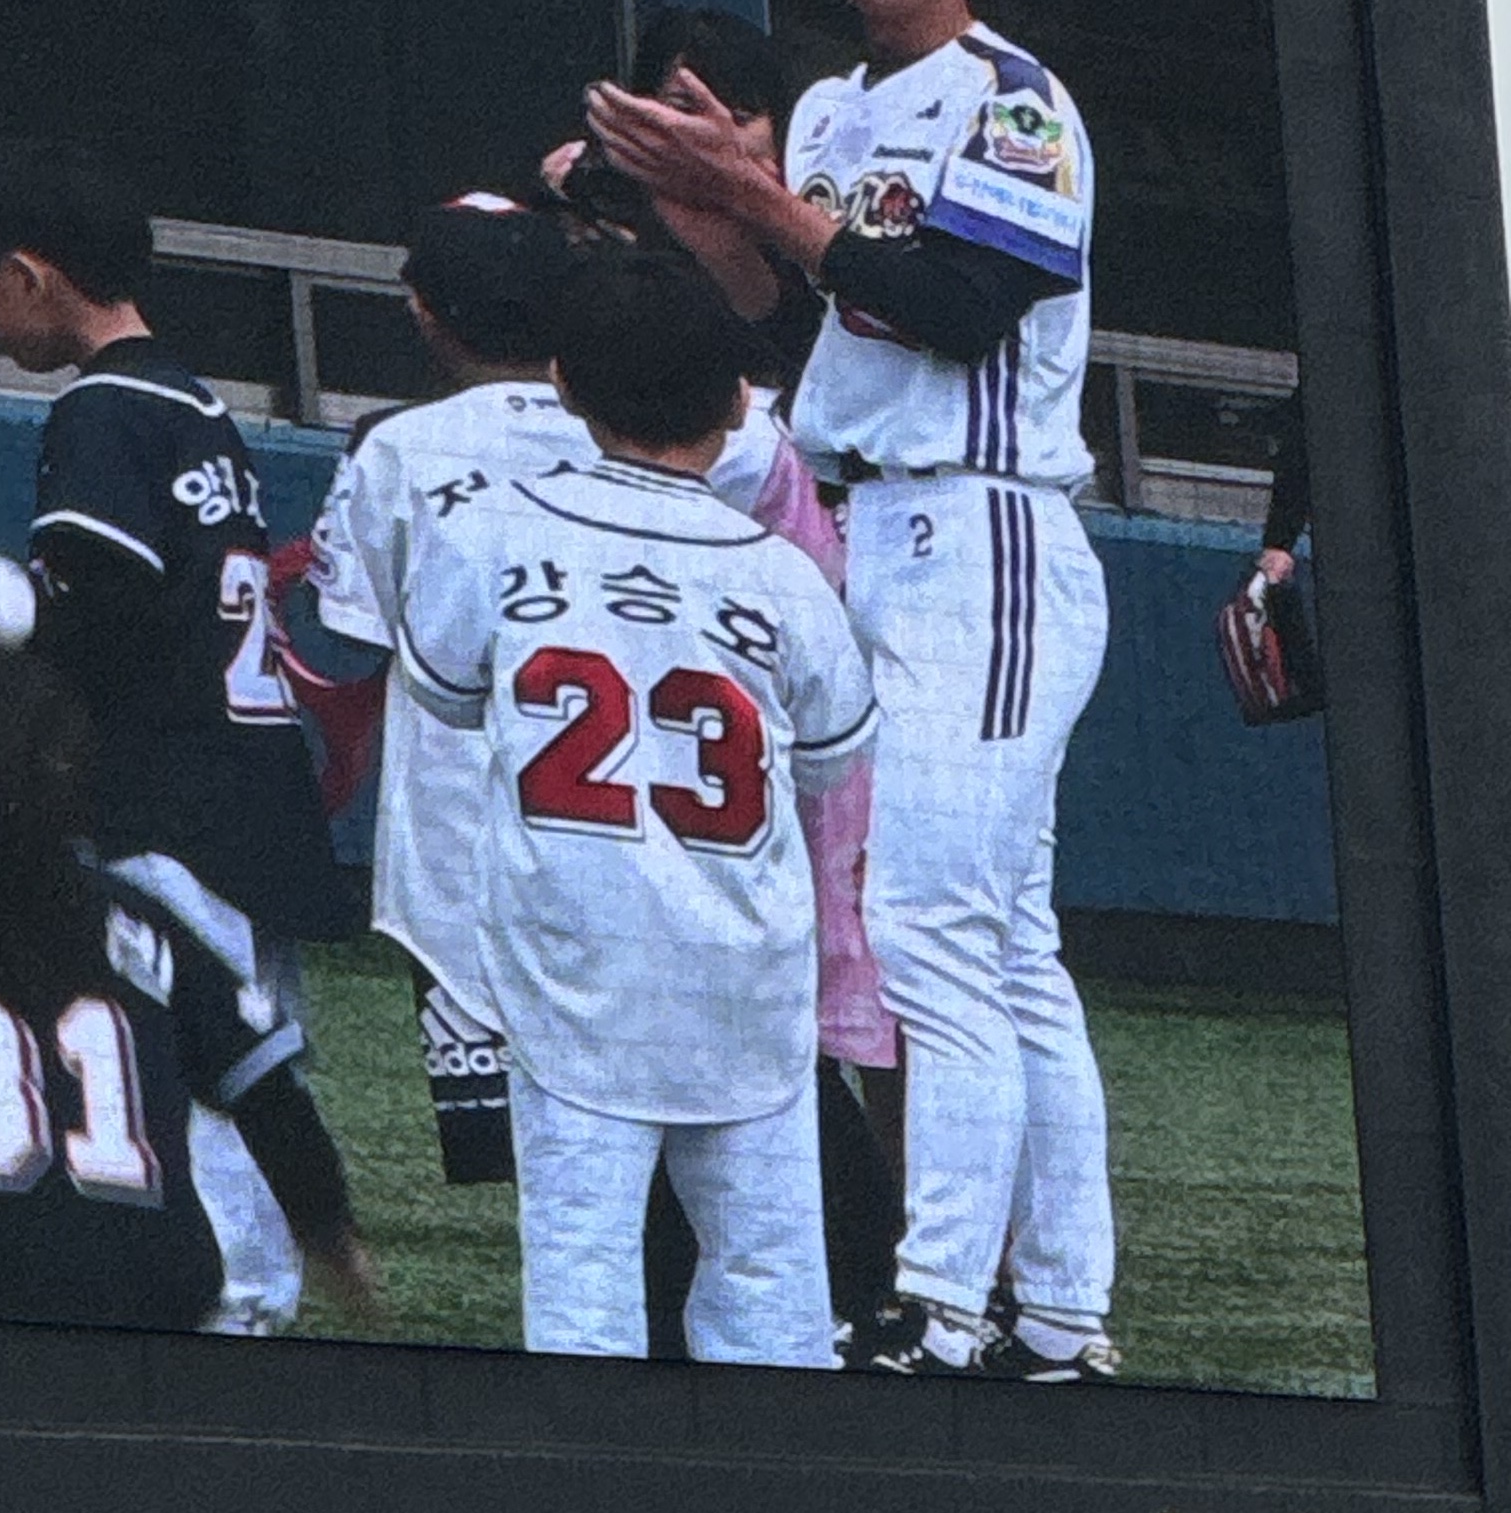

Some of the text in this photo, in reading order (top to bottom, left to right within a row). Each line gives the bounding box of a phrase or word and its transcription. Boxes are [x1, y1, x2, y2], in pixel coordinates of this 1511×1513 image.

[909, 513, 934, 557] 2
[499, 560, 778, 672] 강승호
[513, 645, 775, 860] 23
